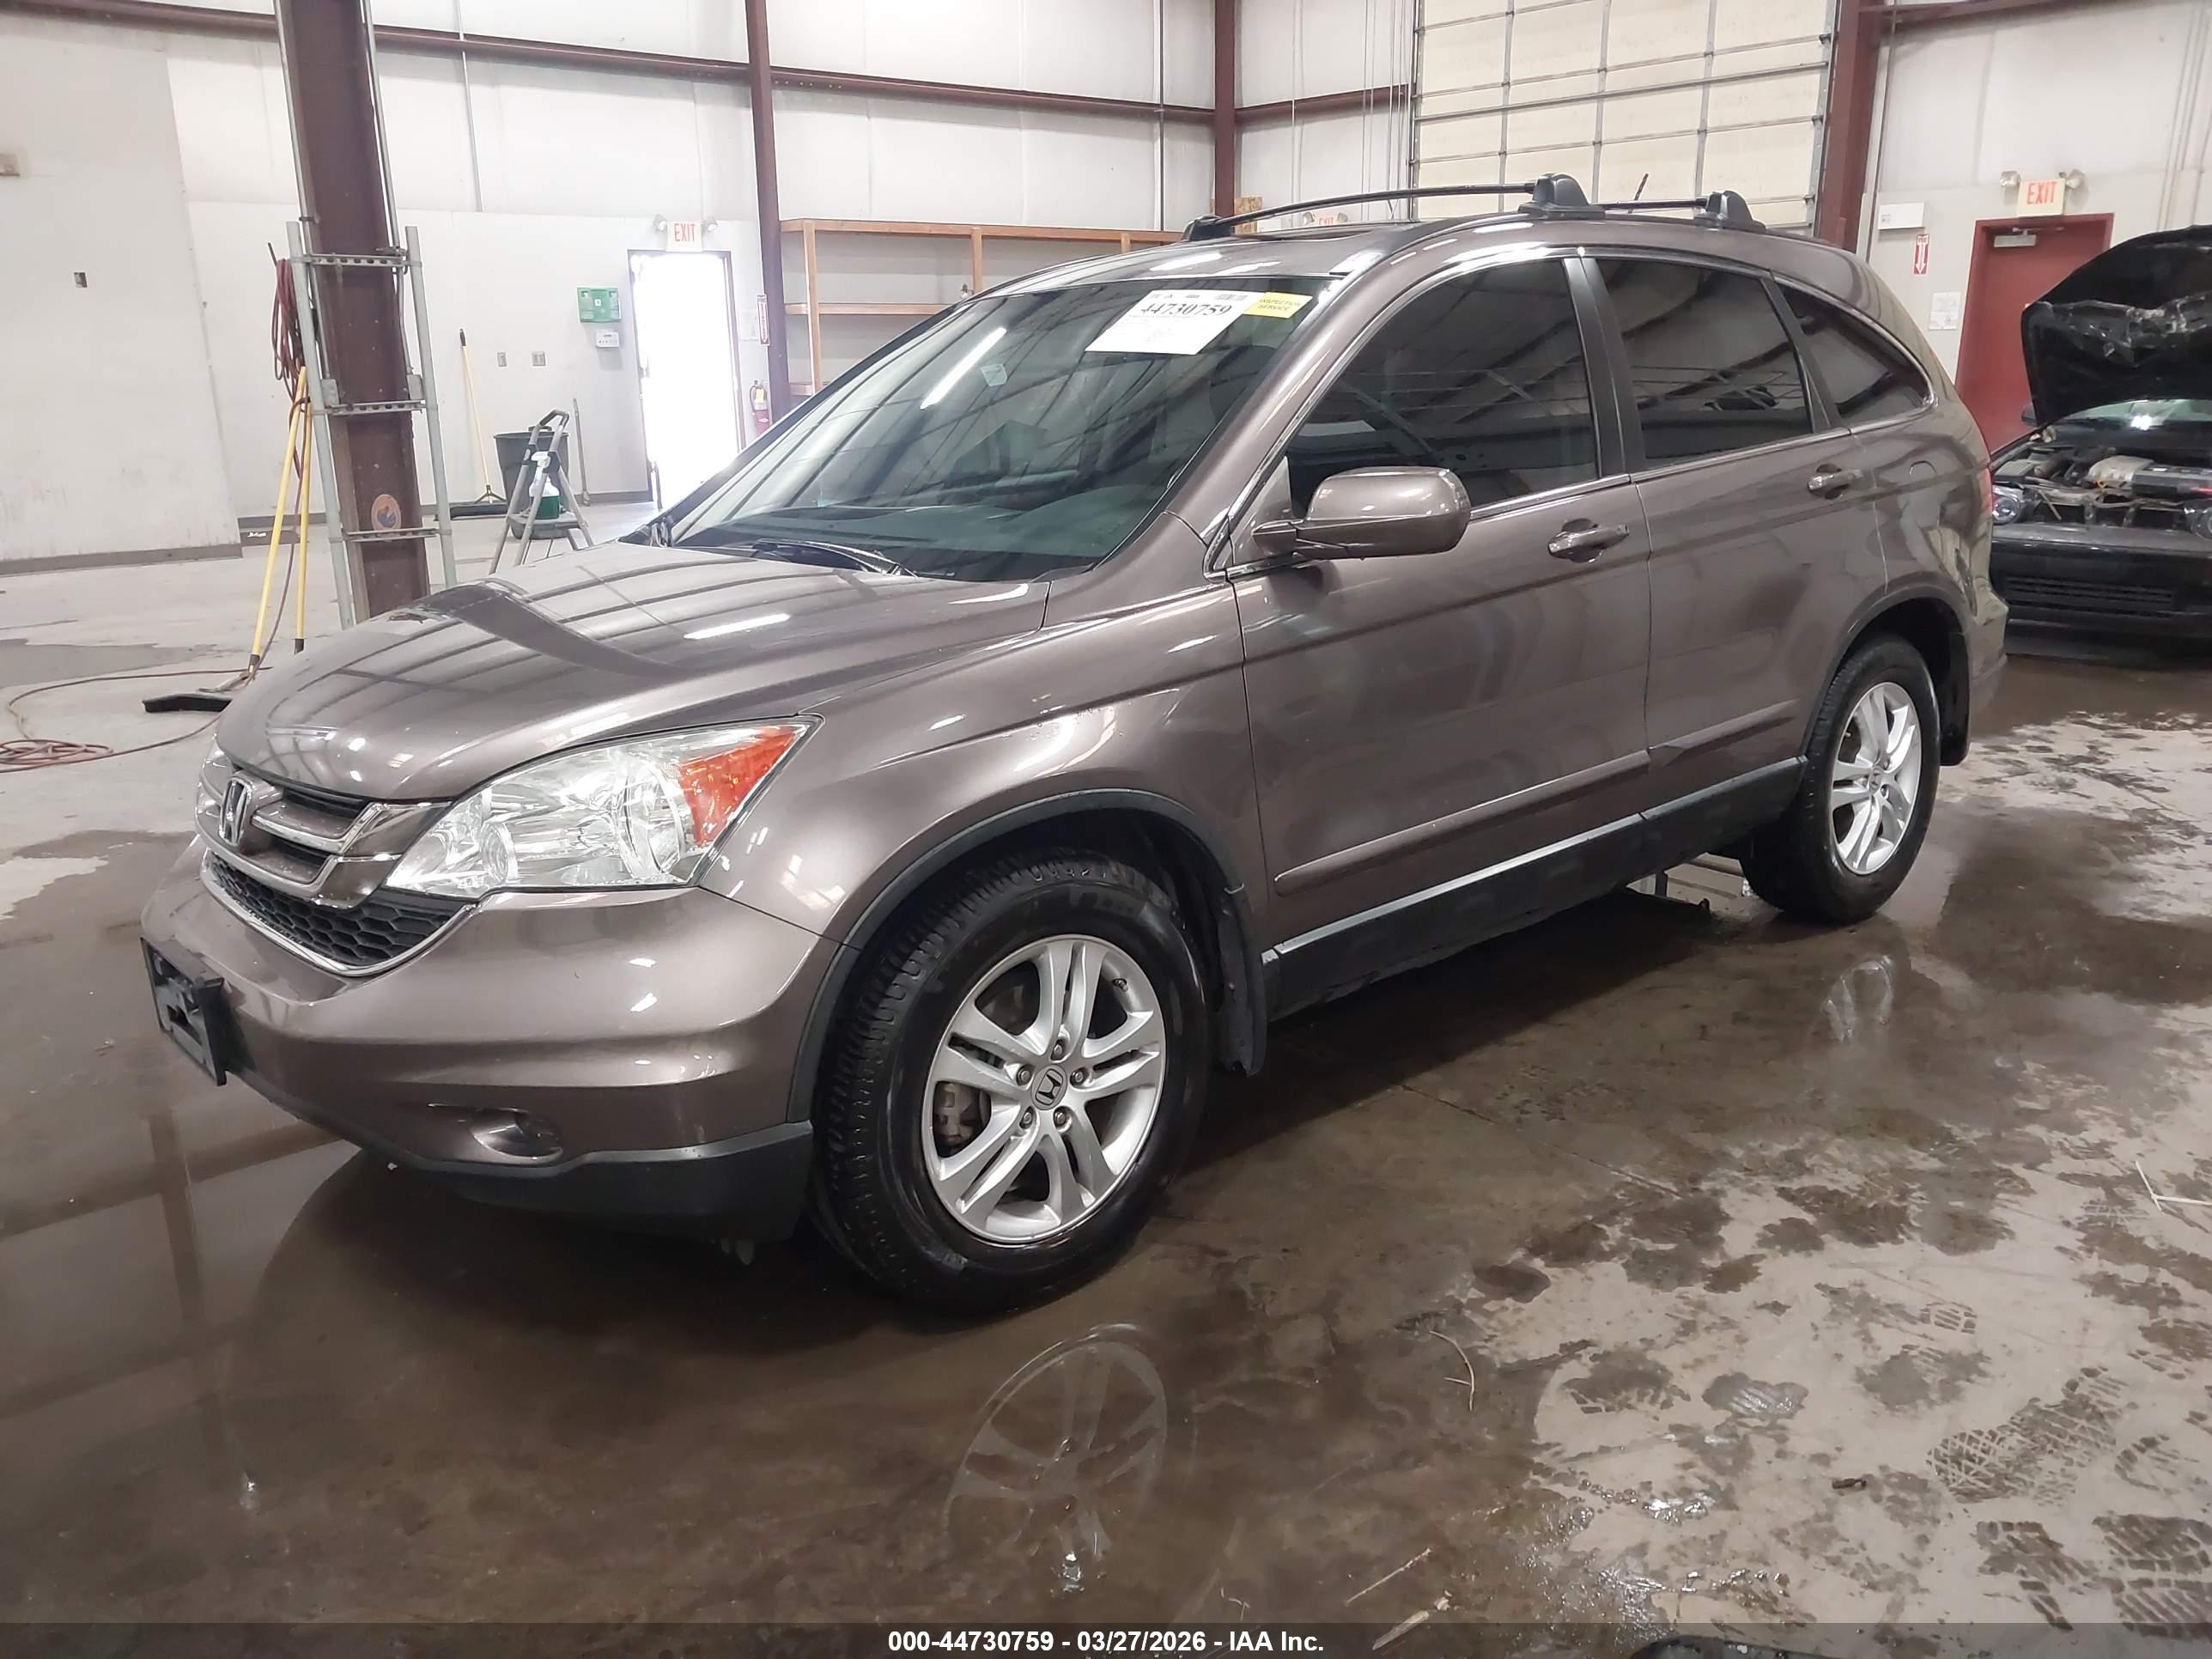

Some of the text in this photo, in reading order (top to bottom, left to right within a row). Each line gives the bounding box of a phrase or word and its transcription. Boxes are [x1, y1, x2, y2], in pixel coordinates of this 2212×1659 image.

[2027, 180, 2057, 205] EXIT
[673, 223, 696, 242] EXIT
[1140, 302, 1233, 316] 44730759
